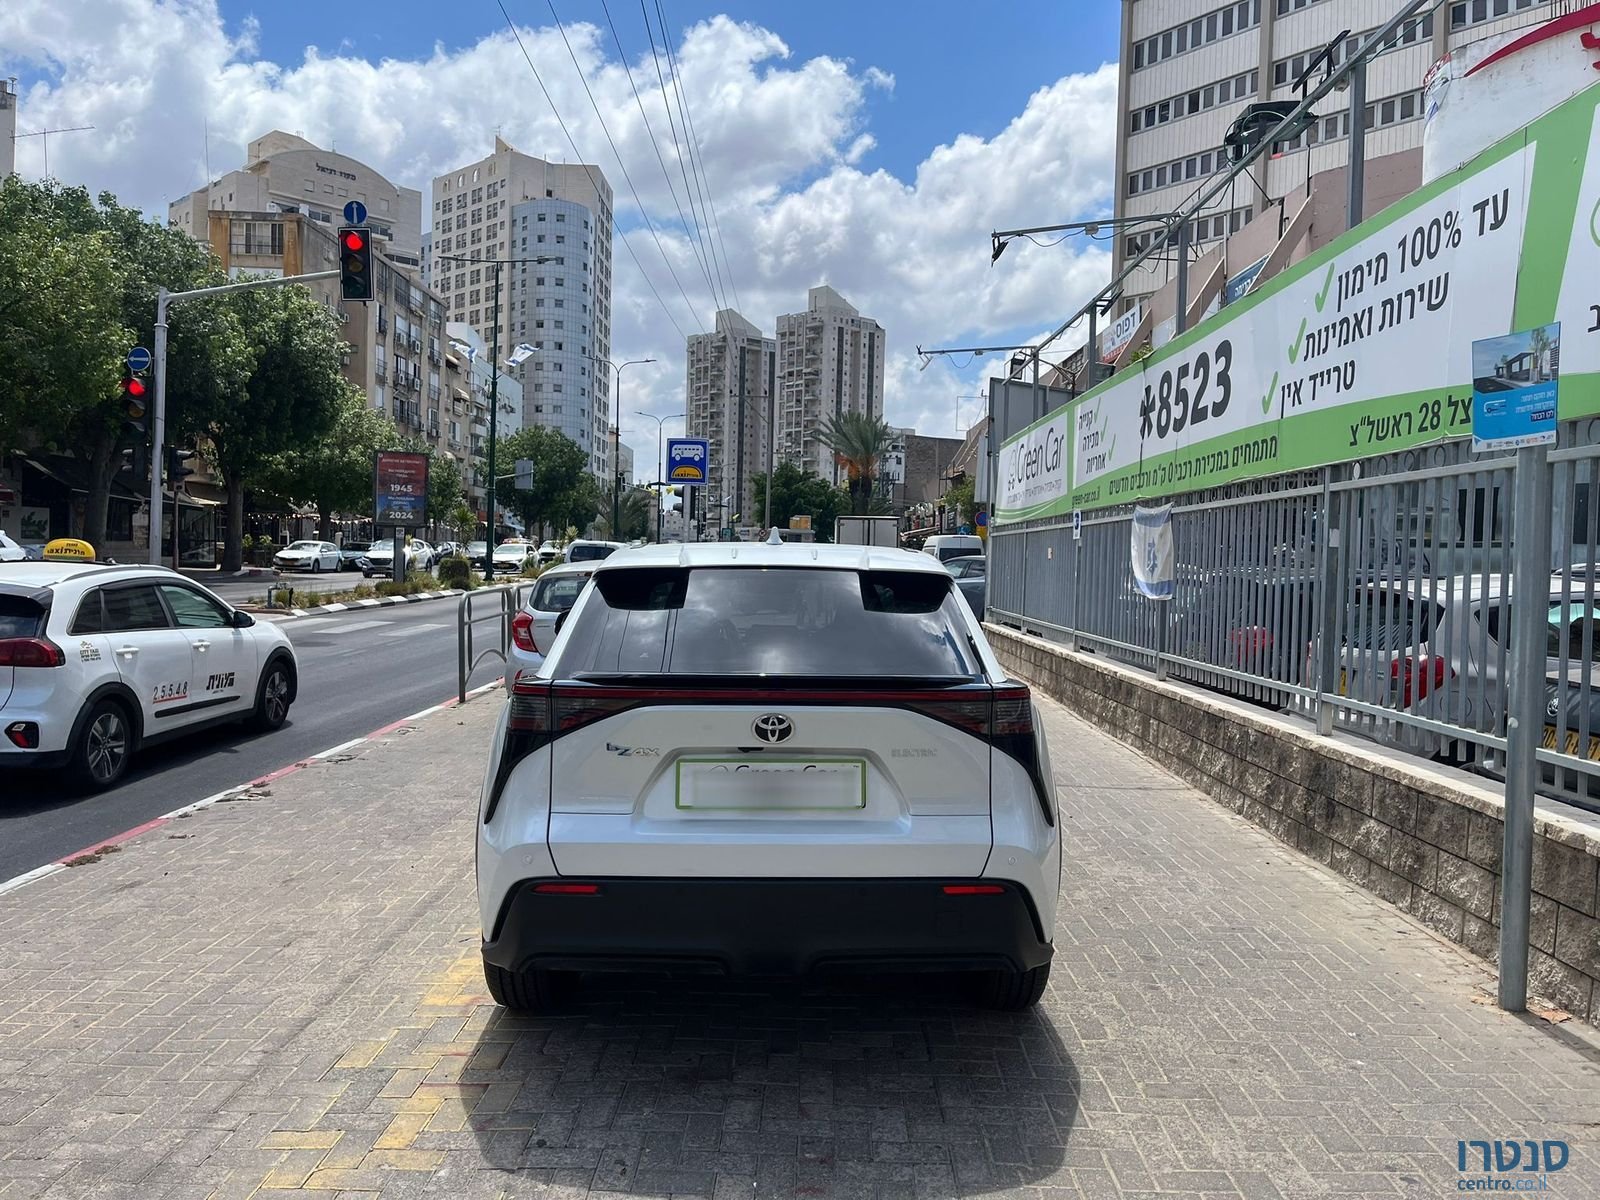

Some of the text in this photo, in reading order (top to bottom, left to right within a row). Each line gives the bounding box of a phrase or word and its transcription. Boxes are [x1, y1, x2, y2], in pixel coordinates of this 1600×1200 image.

[1337, 188, 1509, 313] עד 100% מימון
[1115, 313, 1136, 339] דפוס
[1303, 271, 1450, 362] שירות ואמינות
[1280, 359, 1356, 419] טרייד אין
[1418, 399, 1441, 433] 28
[1447, 394, 1473, 427] צל
[1045, 427, 1065, 473] Car
[1082, 431, 1100, 452] מכירה
[1232, 435, 1278, 468] מתמחים
[1085, 452, 1107, 475] אחריות
[1175, 457, 1192, 481] רכבי
[1193, 452, 1229, 477] במכירת
[390, 484, 413, 492] 1945
[1108, 475, 1129, 496] חדשים
[1130, 468, 1151, 490] ורכבים
[389, 511, 414, 520] 2024
[64, 547, 86, 556] מונית
